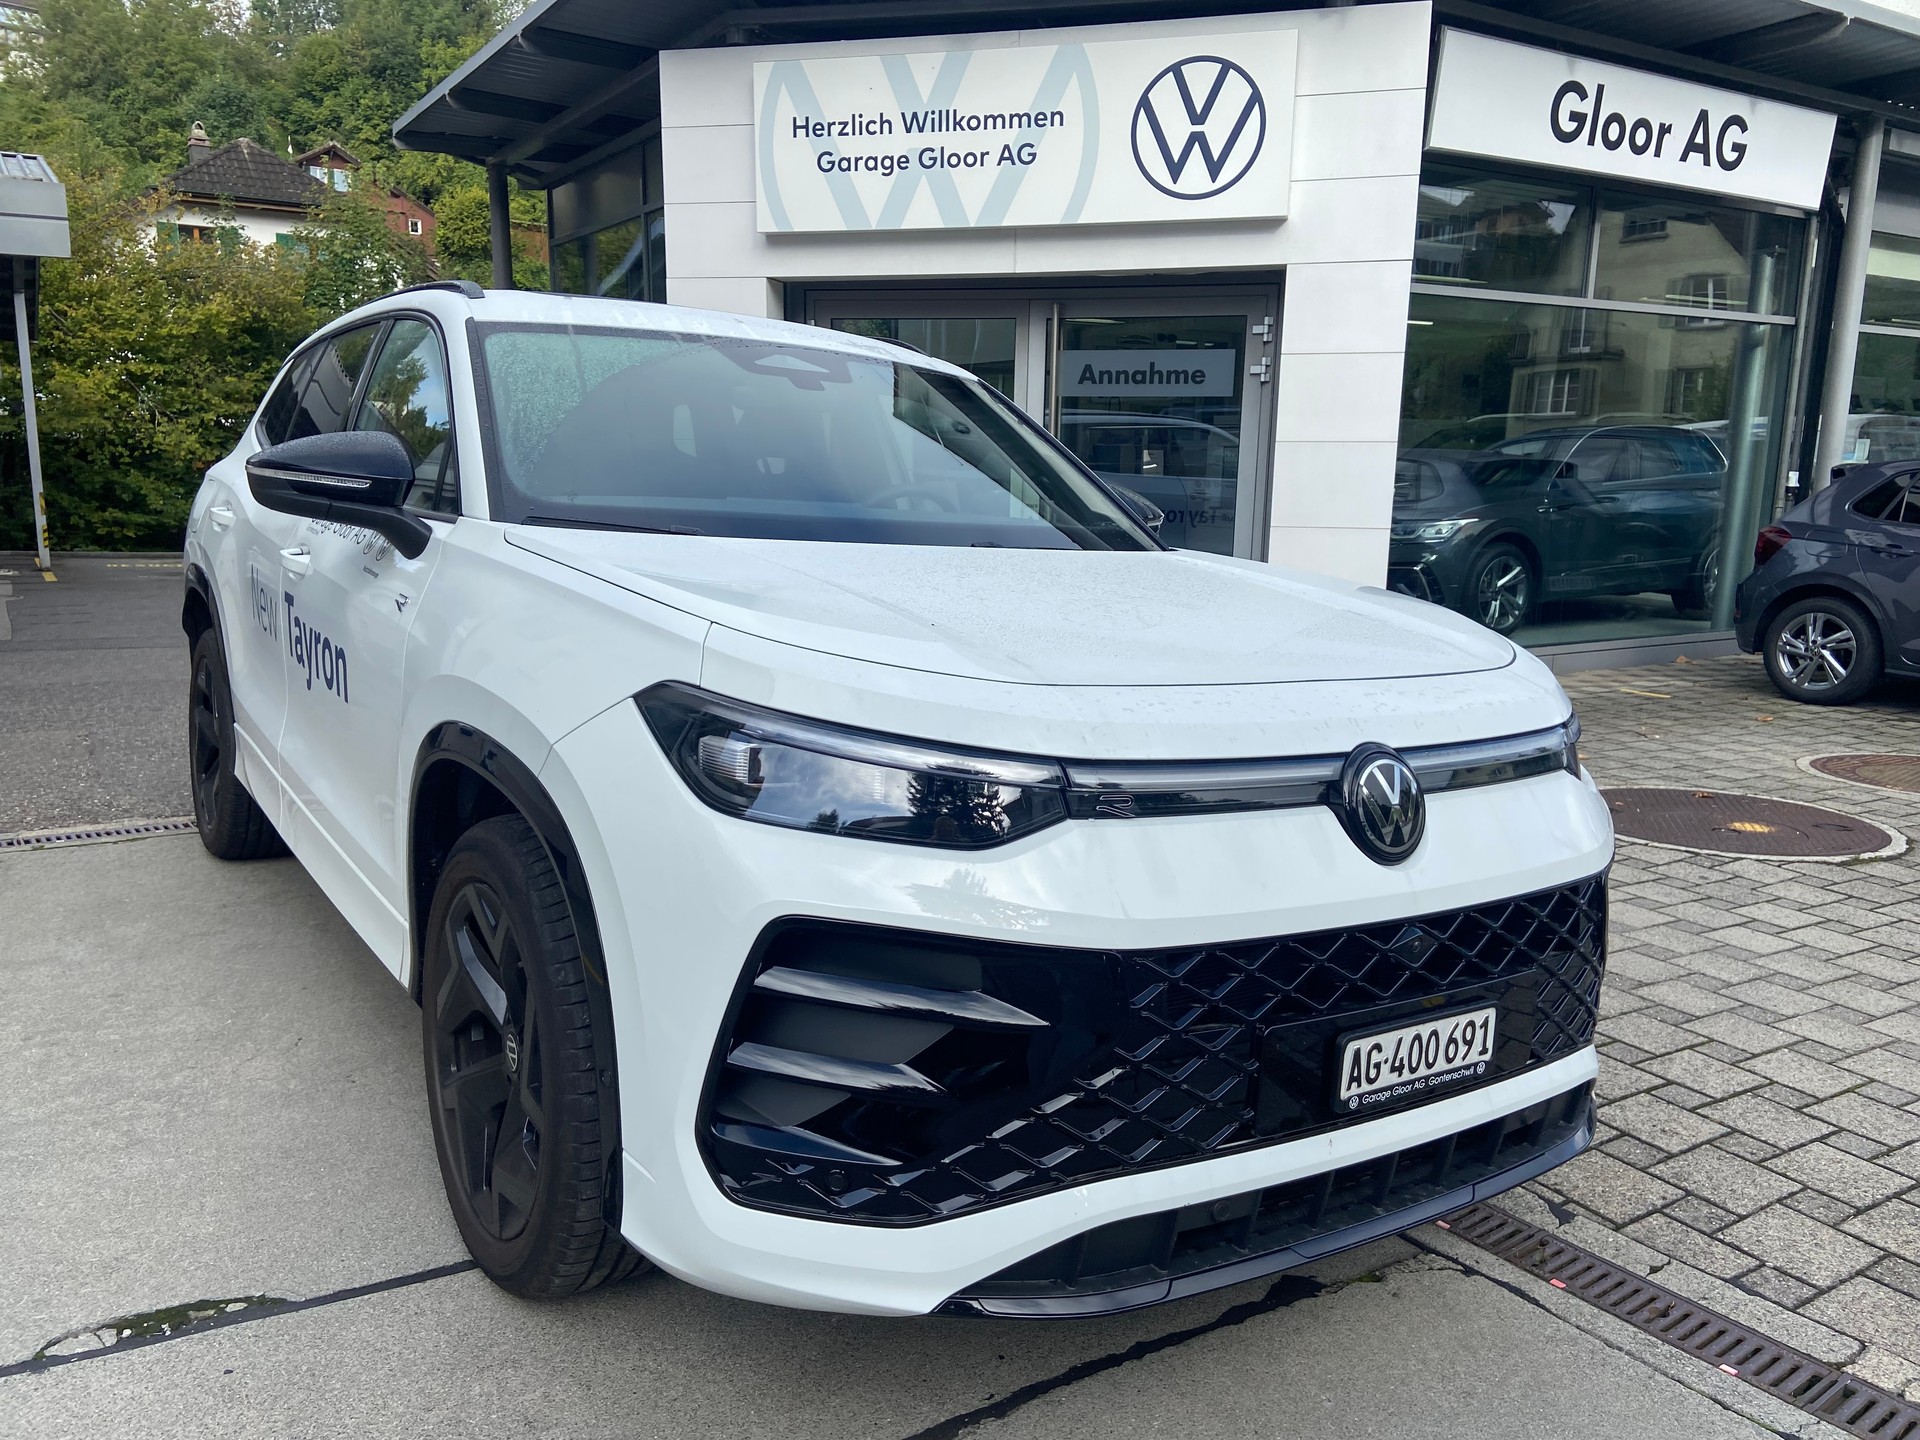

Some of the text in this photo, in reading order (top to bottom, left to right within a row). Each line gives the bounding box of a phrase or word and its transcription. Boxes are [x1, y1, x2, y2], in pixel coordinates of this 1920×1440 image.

[792, 109, 1065, 138] Herzlich Willkommen
[1550, 80, 1749, 172] Gloor AG
[817, 143, 1037, 176] Garage Gloor AG
[1077, 361, 1206, 385] Annahme
[251, 563, 349, 704] New Tayron
[1362, 1089, 1391, 1104] Garage
[1392, 1083, 1412, 1096] Gloor
[1413, 1079, 1425, 1089] AG
[1428, 1066, 1475, 1086] Gontenschwil
